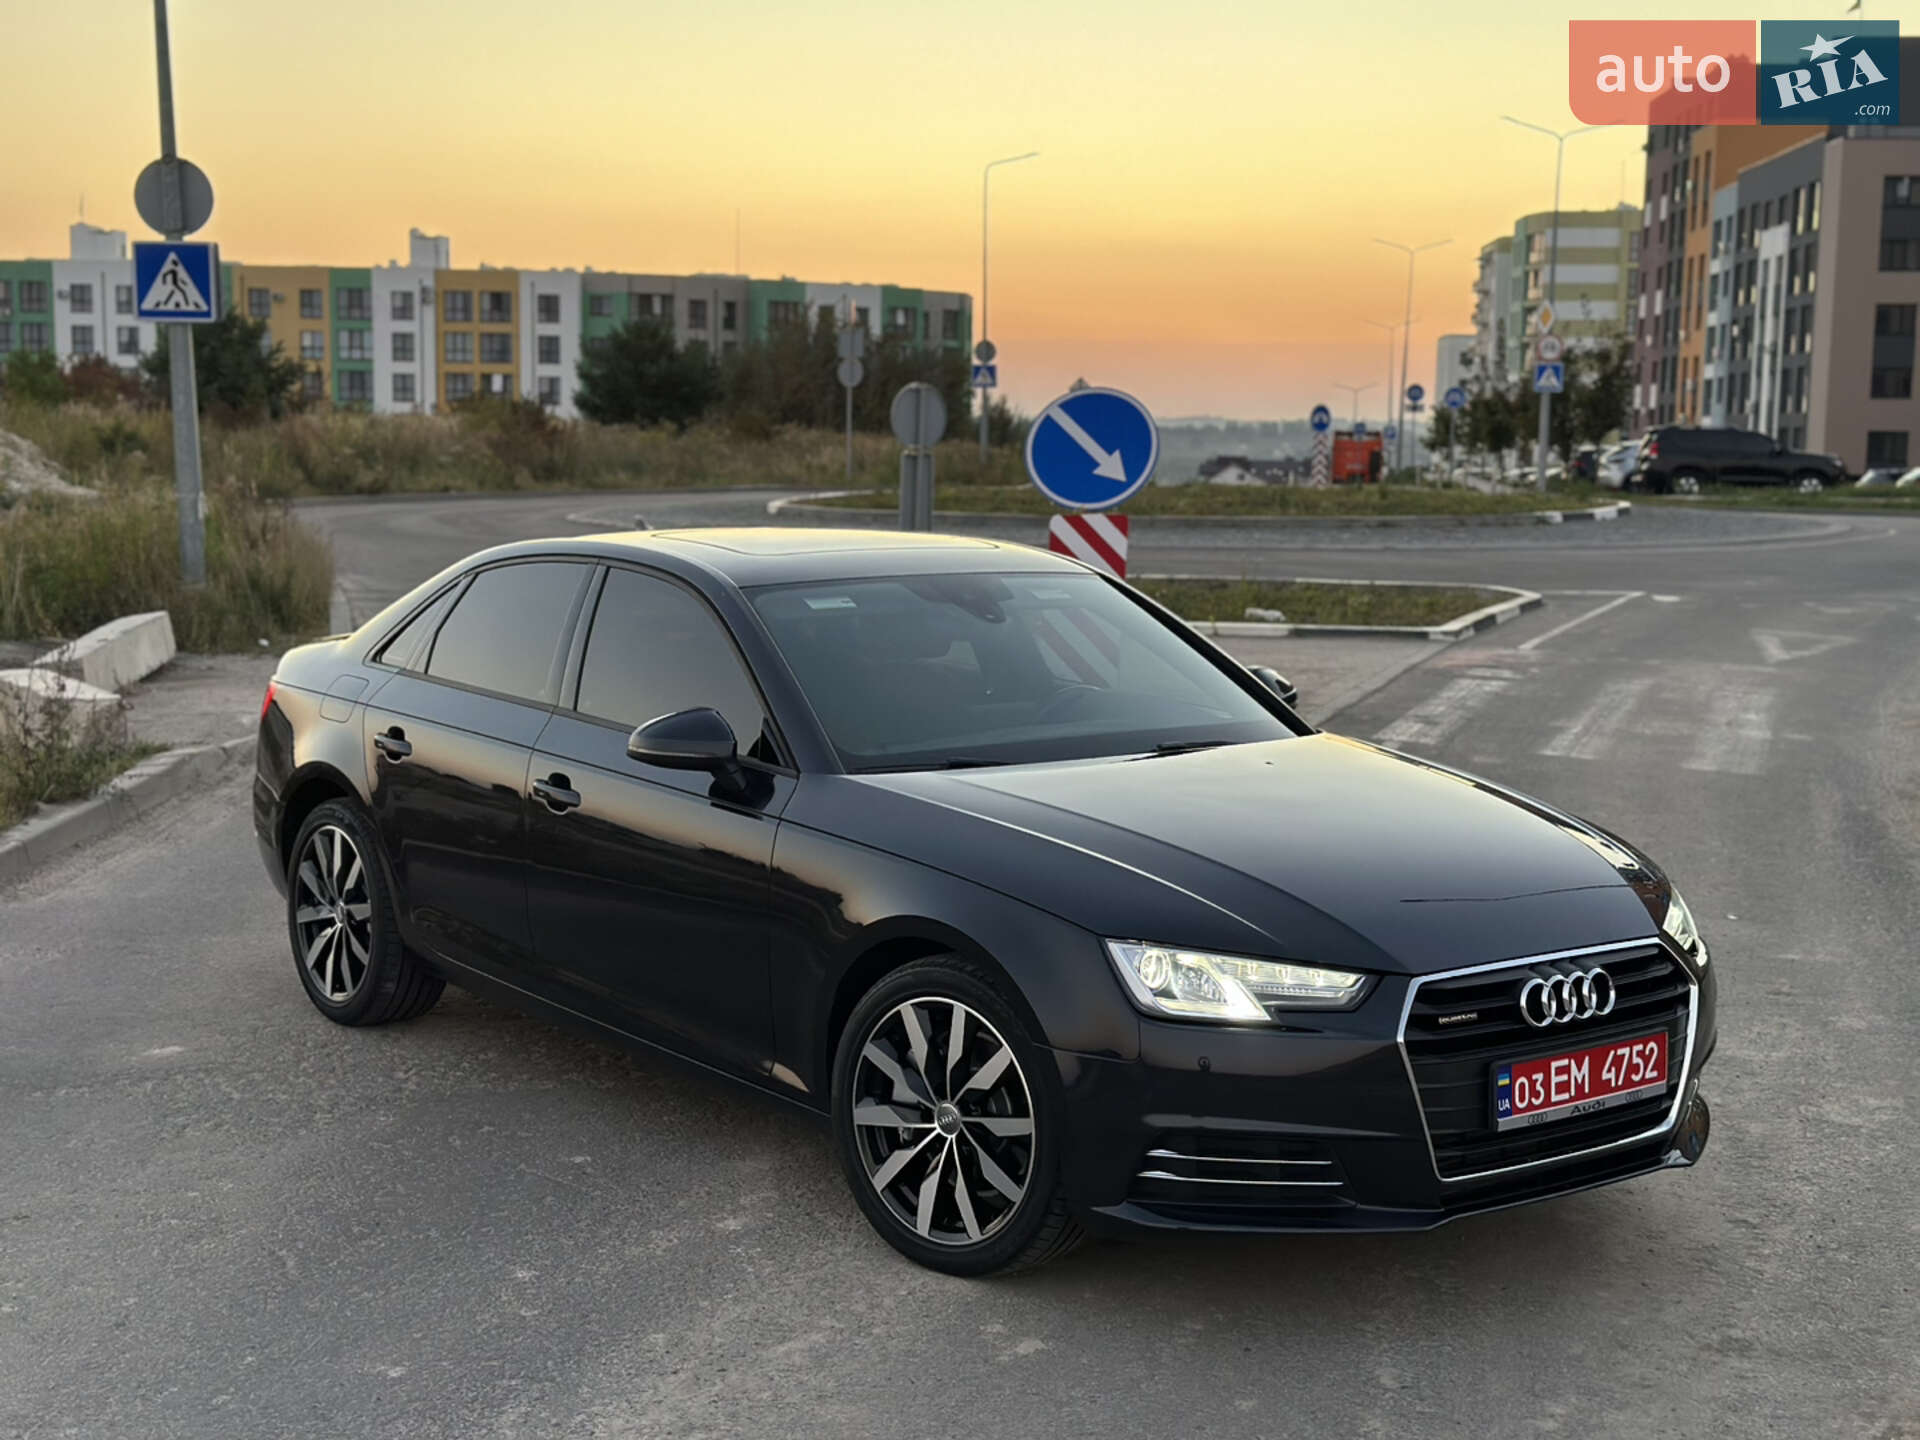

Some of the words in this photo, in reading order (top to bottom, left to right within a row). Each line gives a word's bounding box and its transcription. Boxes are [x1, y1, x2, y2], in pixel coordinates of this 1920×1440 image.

[1601, 1041, 1659, 1088] 4752
[1498, 1098, 1511, 1111] UA
[1570, 1101, 1606, 1116] Audi
